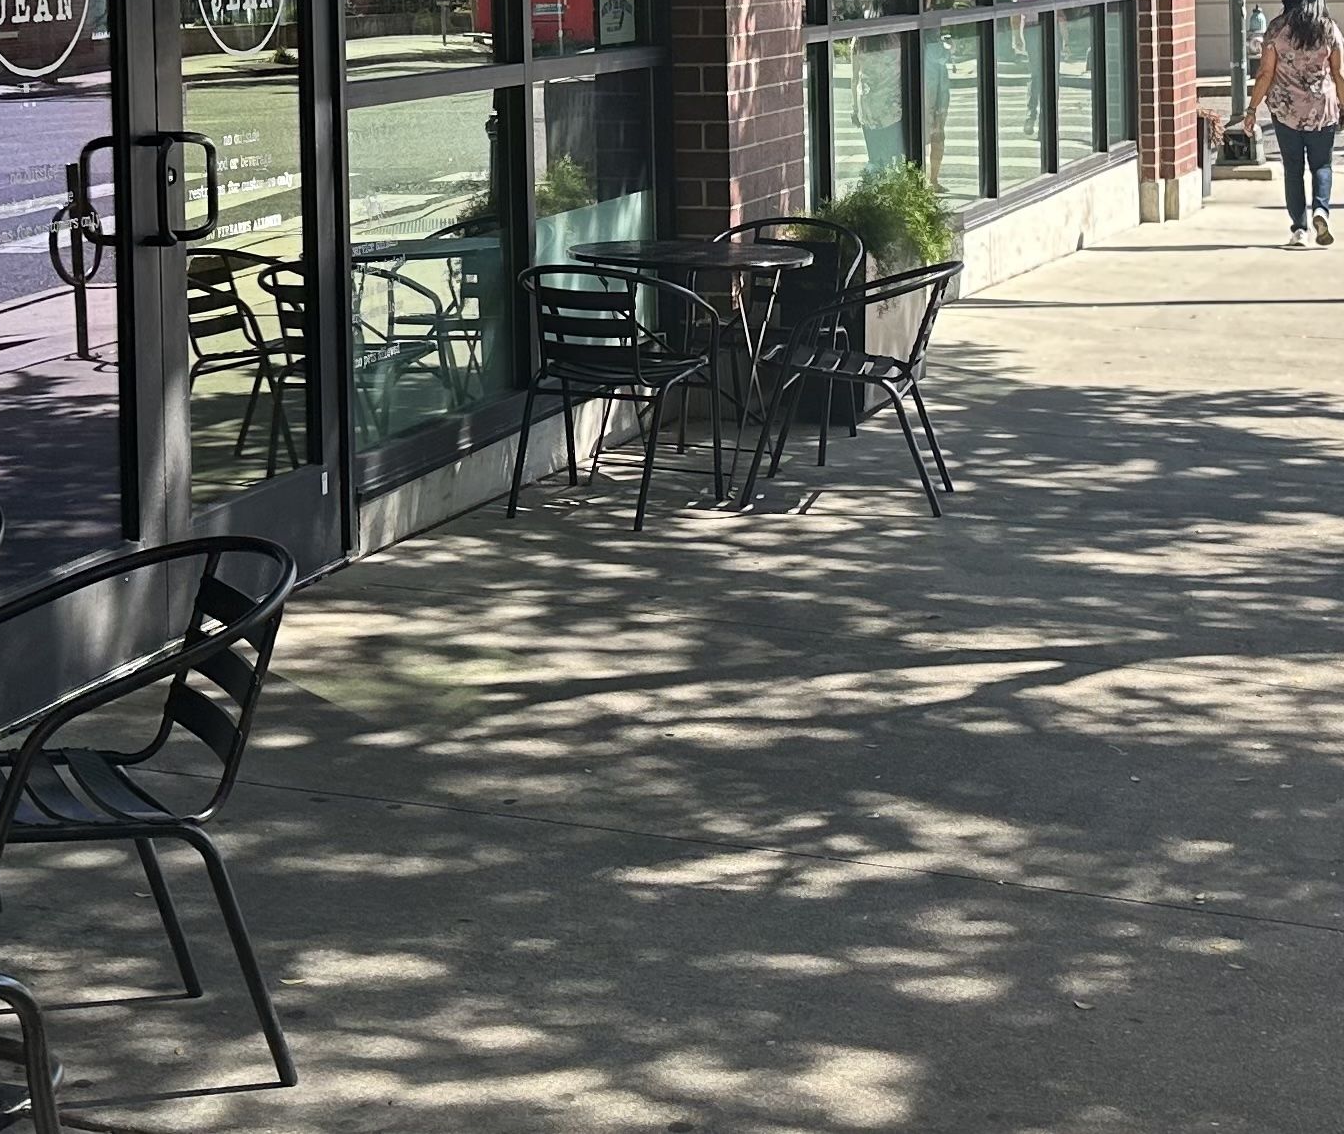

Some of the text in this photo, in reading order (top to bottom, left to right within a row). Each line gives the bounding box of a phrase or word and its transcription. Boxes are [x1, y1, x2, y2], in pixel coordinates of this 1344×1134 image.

[227, 180, 240, 195] for
[277, 172, 294, 188] only
[17, 224, 32, 241] for
[81, 211, 101, 233] only
[217, 220, 252, 239] FIREARMS
